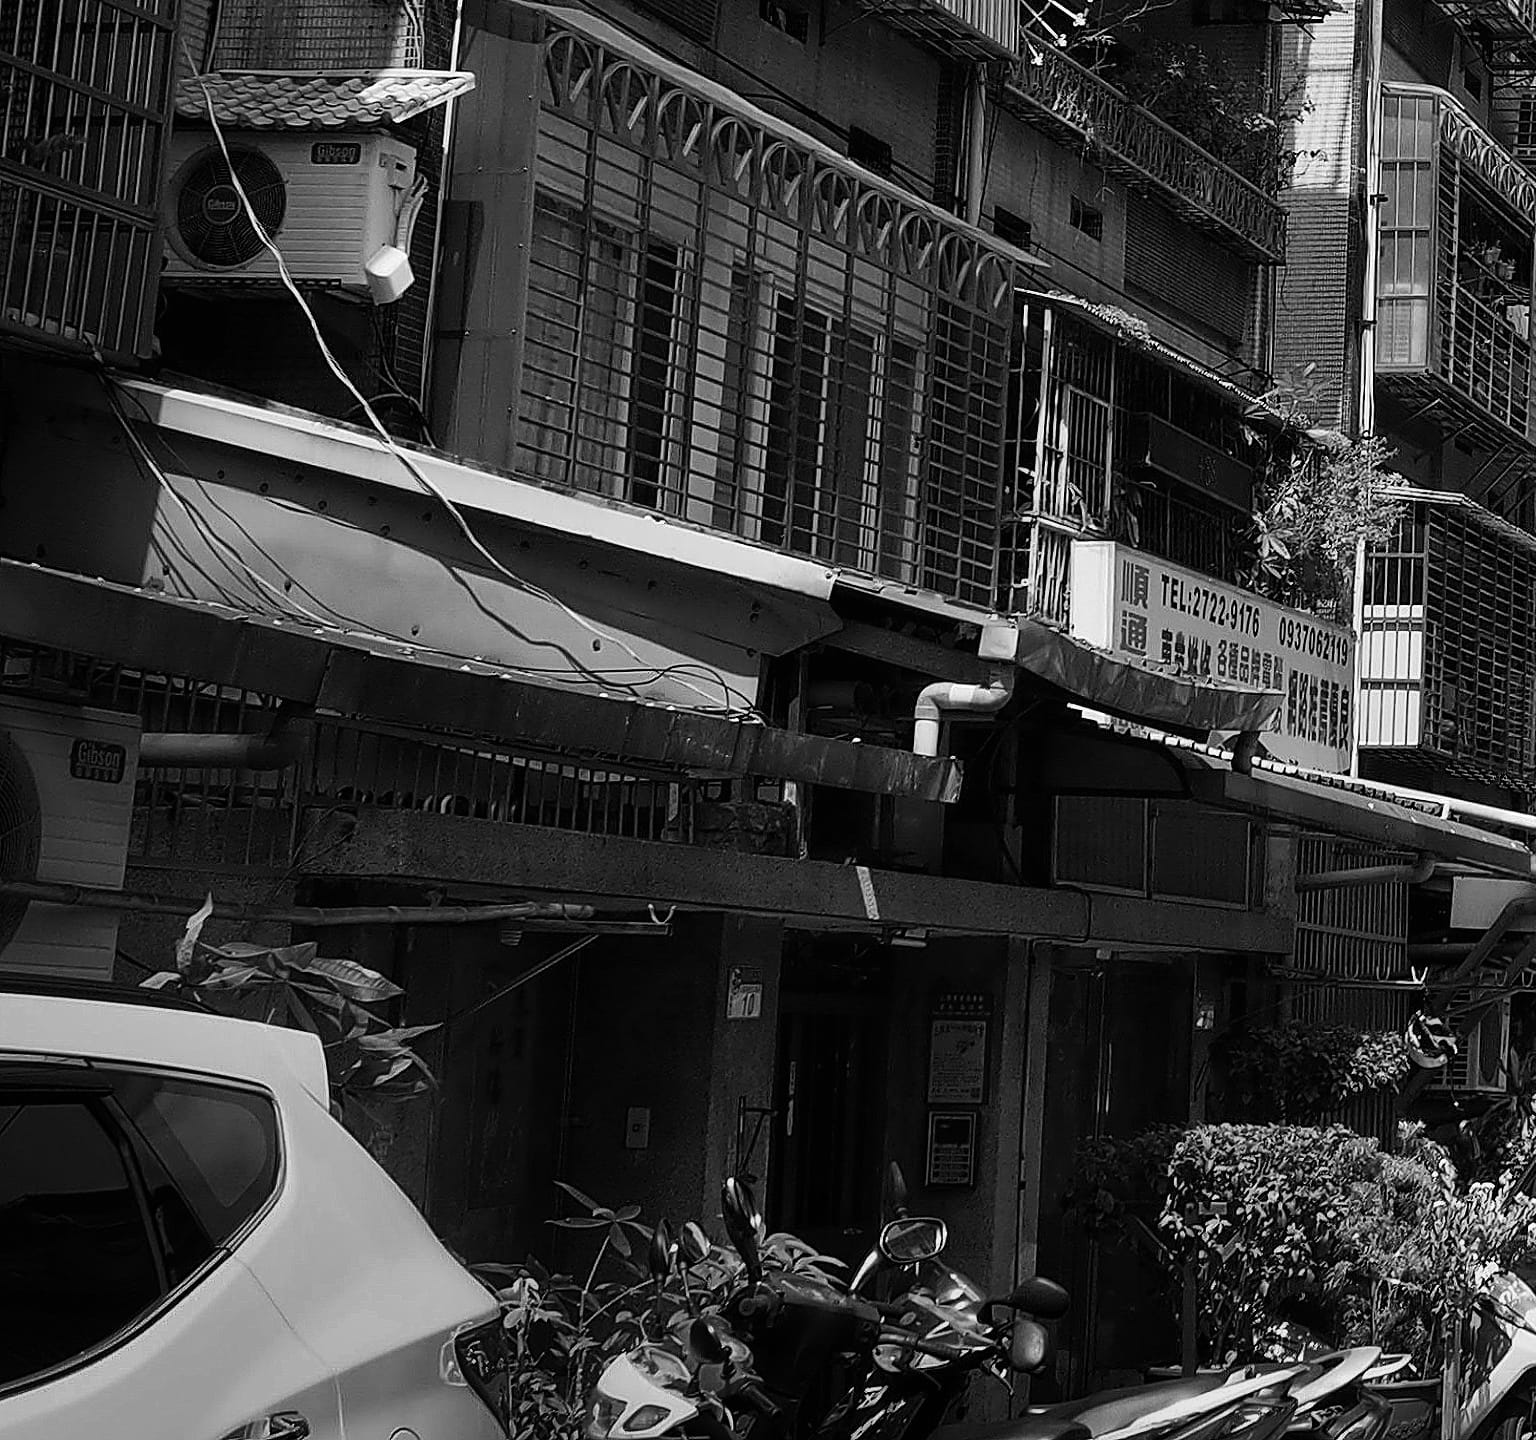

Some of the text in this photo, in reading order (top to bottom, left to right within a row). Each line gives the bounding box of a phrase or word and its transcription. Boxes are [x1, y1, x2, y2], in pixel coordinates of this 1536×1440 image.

[1278, 615, 1350, 667] 0937062119
[78, 741, 120, 768] Gibson
[741, 993, 755, 1016] 10
